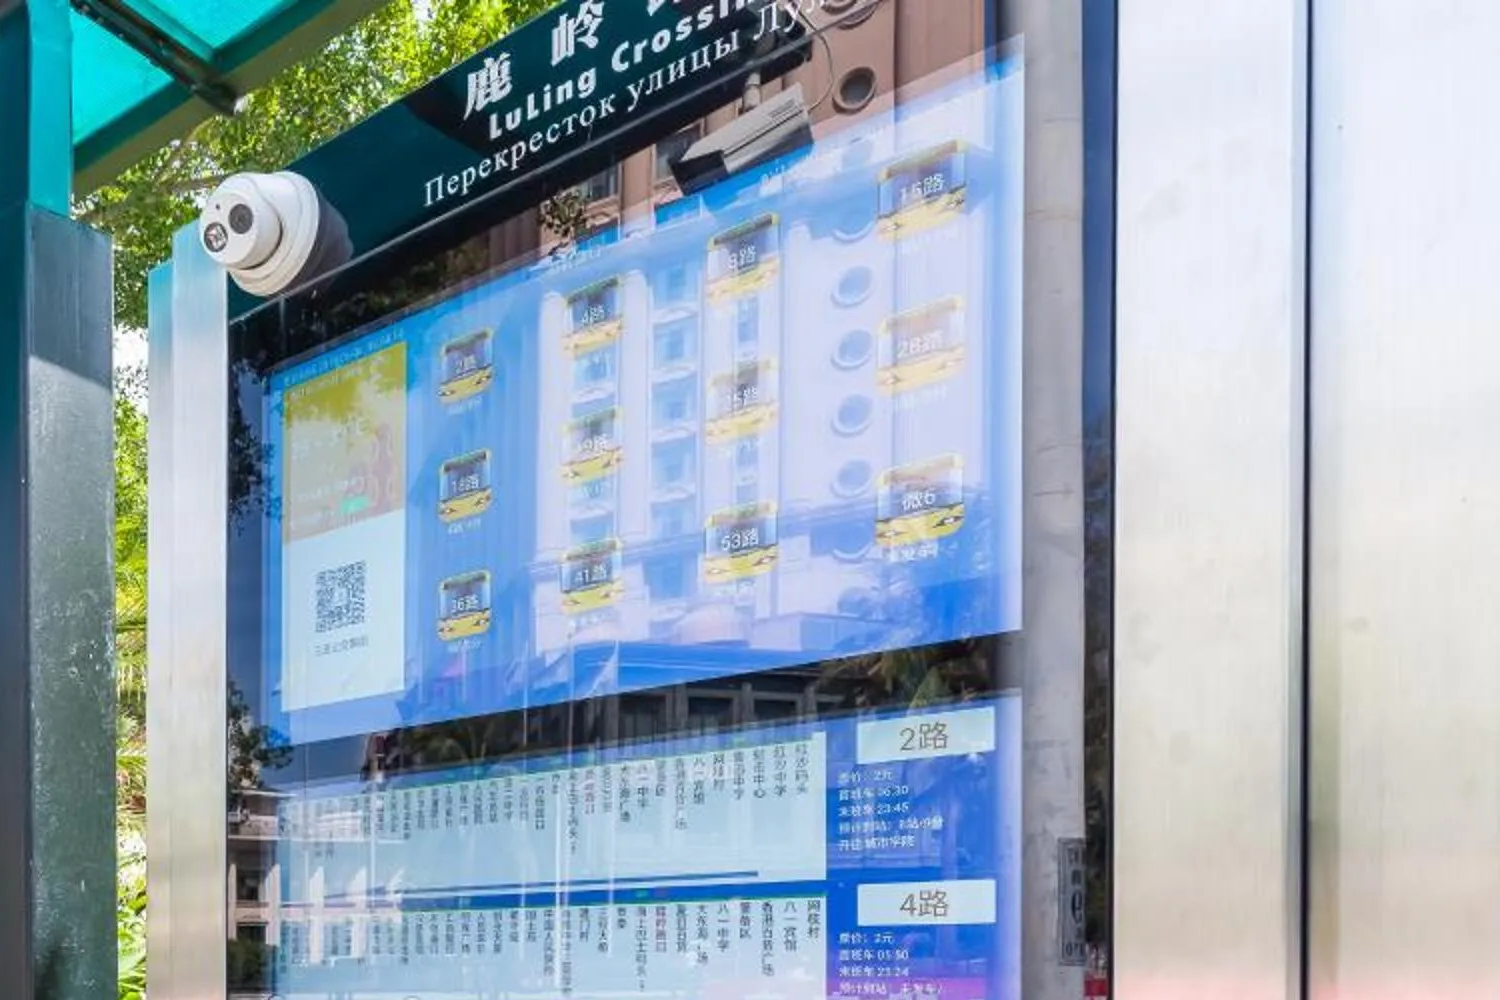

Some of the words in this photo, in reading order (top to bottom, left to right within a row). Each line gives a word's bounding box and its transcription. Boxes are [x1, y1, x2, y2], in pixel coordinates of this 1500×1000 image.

[424, 97, 615, 207] Перекресток
[626, 30, 740, 113] улицы
[753, 0, 820, 41] Лу
[489, 67, 598, 139] LuLing
[900, 722, 949, 750] 2路
[900, 890, 949, 918] 4路
